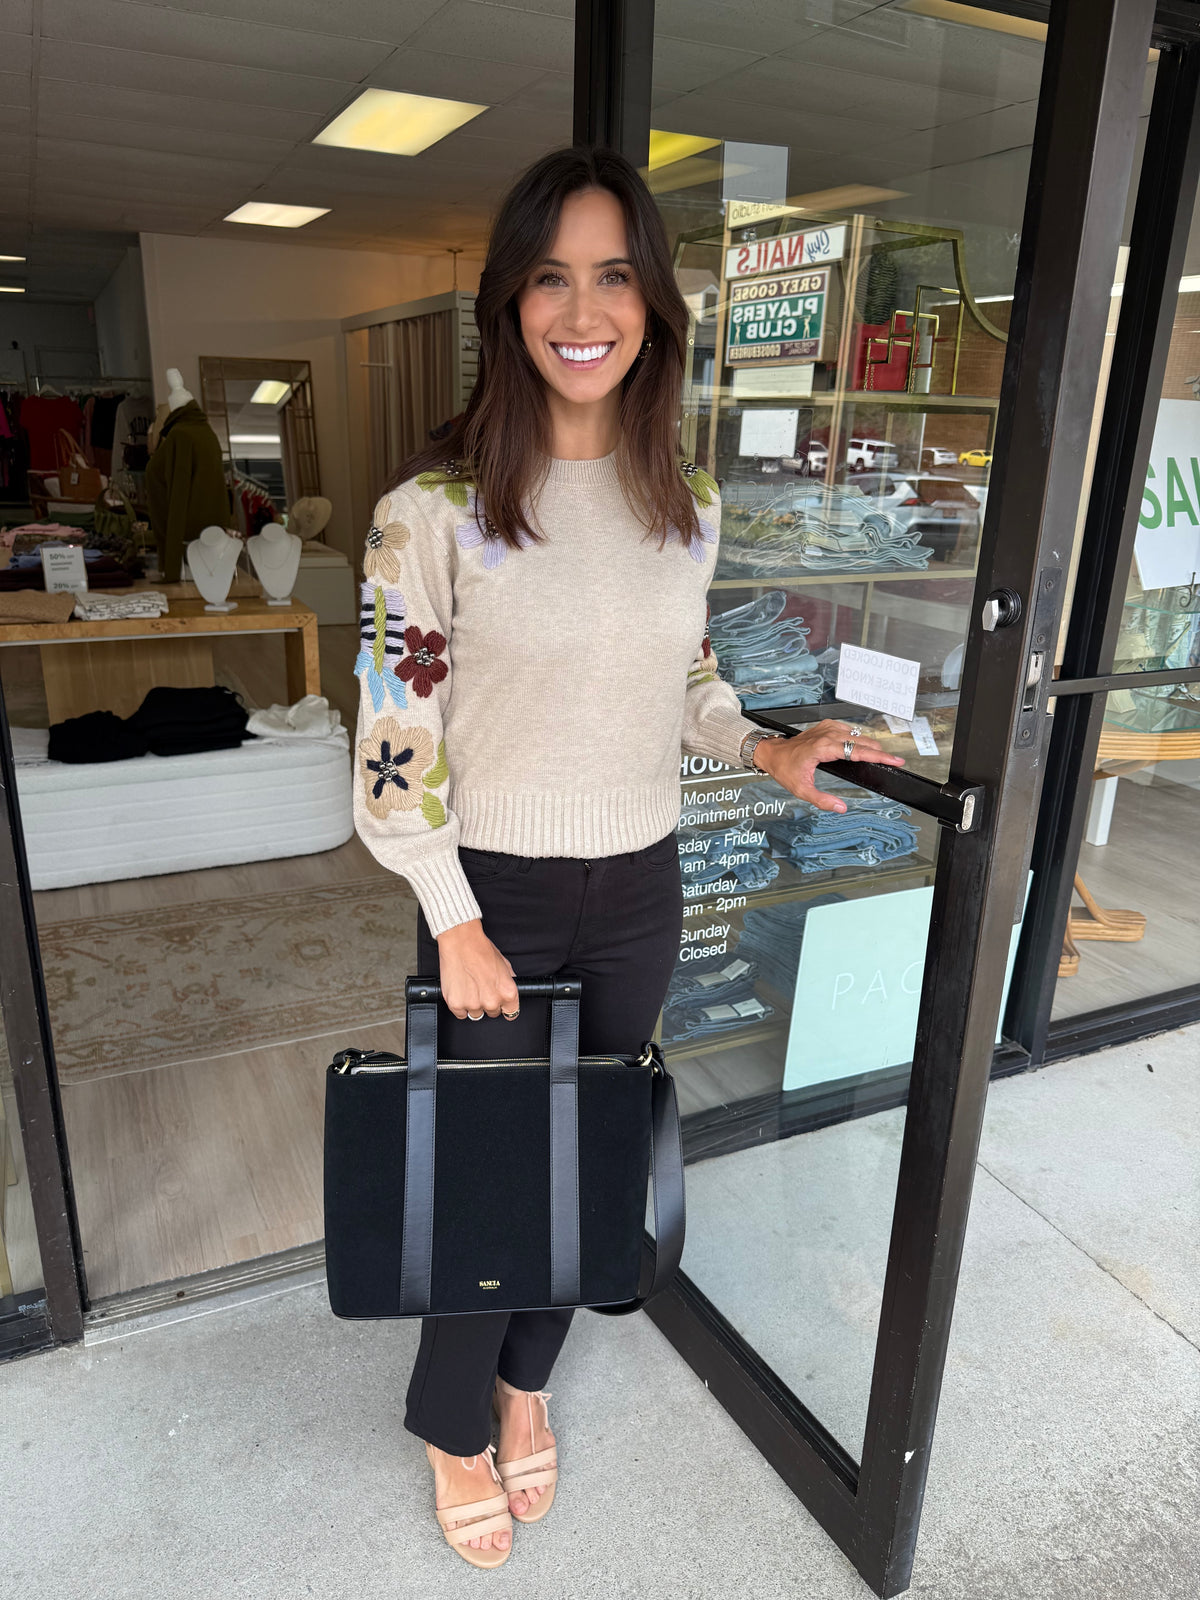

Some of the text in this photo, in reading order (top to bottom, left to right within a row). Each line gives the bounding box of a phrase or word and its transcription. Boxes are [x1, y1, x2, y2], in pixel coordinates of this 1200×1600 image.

[681, 755, 740, 776] HOU
[683, 787, 742, 806] Monday
[677, 799, 786, 832] pointment Only
[678, 838, 712, 855] sday
[724, 830, 766, 847] Friday
[719, 853, 750, 869] 4pm
[683, 903, 704, 918] am
[715, 896, 747, 913] 2pm
[680, 924, 730, 944] Sunday
[679, 940, 727, 962] Closed
